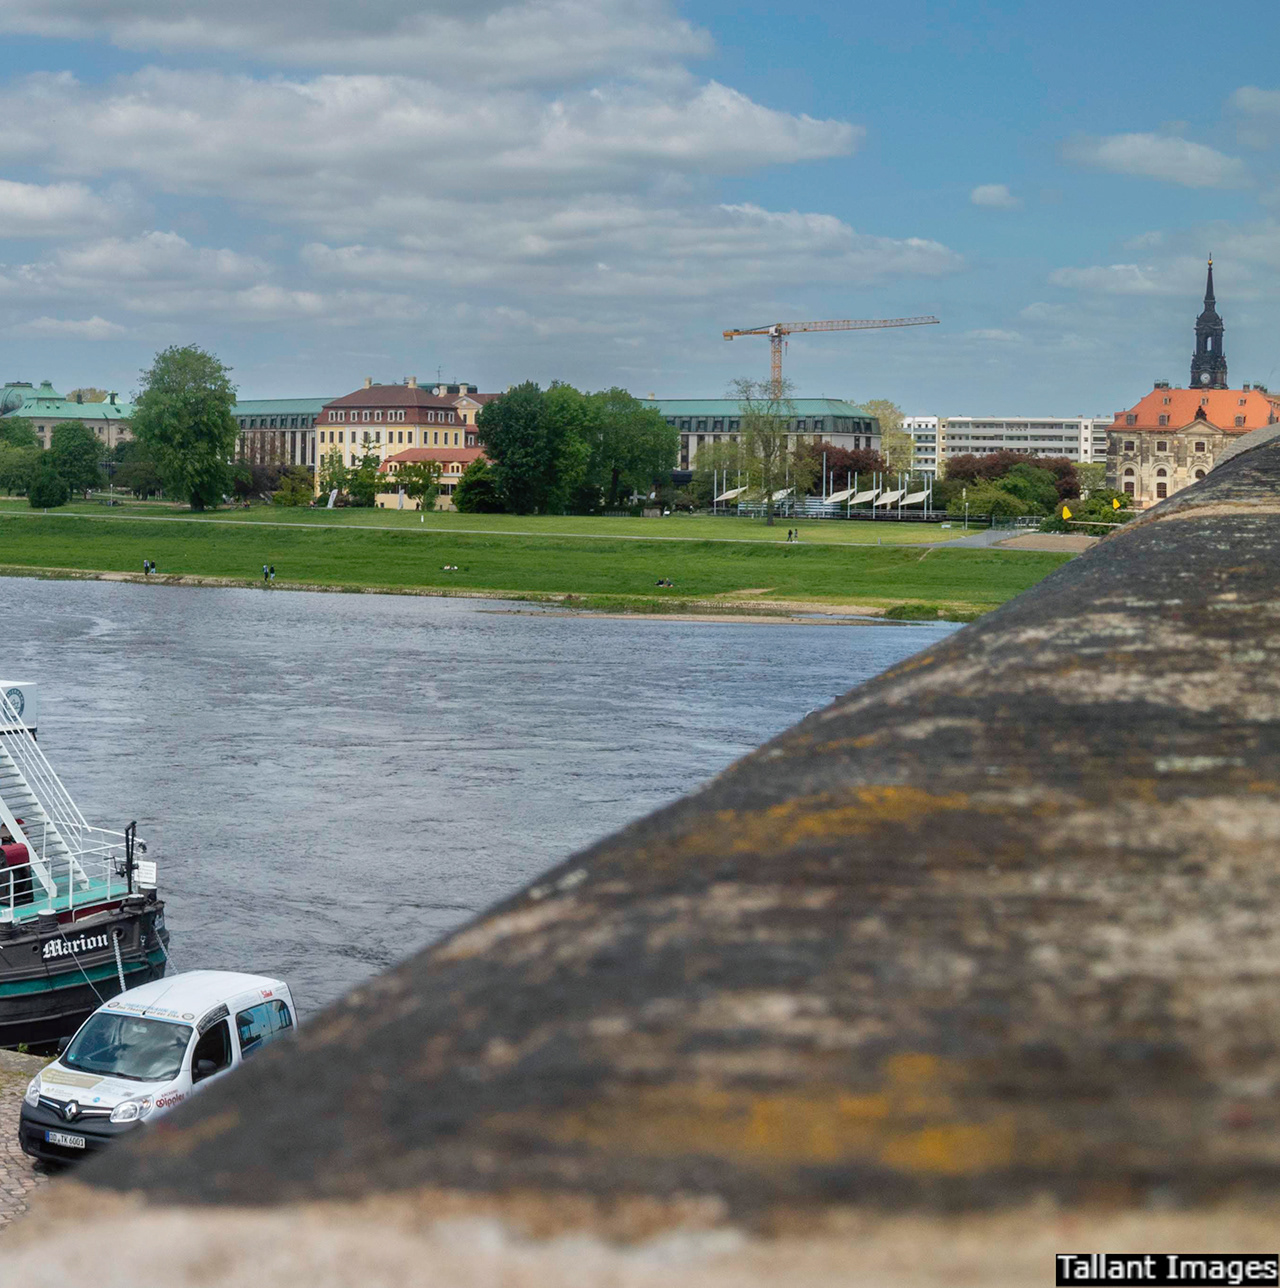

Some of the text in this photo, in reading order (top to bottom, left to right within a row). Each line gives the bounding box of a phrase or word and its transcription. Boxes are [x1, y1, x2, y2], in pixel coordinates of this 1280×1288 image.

[42, 934, 109, 959] Marion
[61, 1134, 68, 1144] TK
[69, 1135, 84, 1147] 6001
